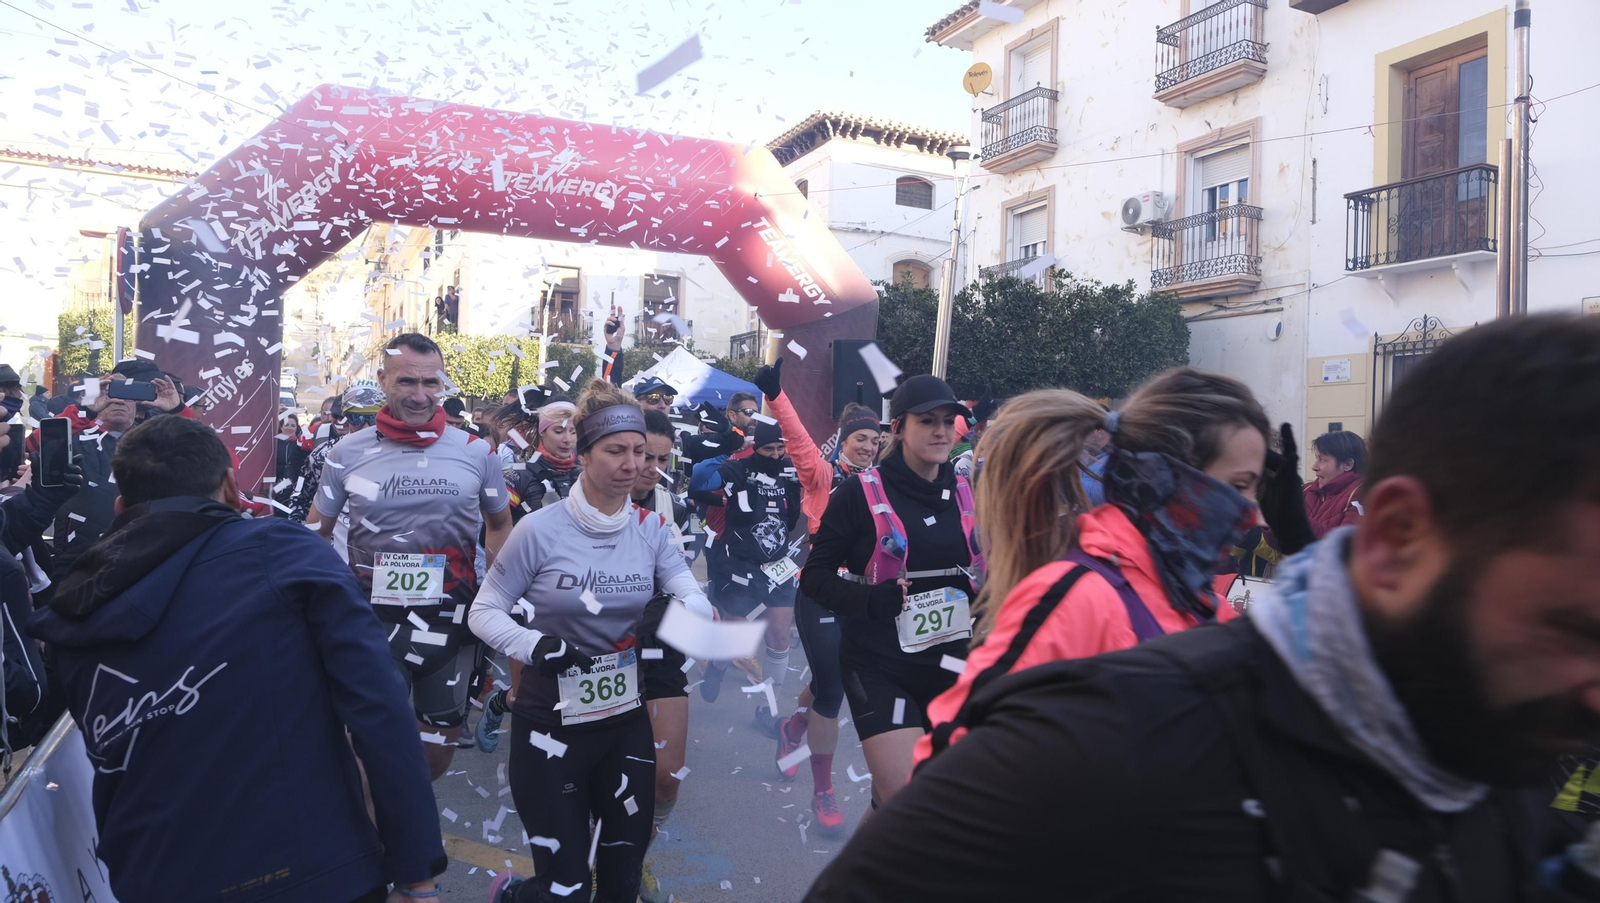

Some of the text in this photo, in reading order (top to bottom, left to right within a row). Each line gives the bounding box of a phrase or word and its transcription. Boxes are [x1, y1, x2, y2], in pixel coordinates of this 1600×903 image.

[503, 170, 627, 201] TEAMERGY
[752, 216, 832, 305] TEAMERGY
[401, 479, 448, 487] CALAR
[771, 560, 788, 577] 237
[386, 571, 430, 591] 202
[598, 574, 642, 584] CALAR
[616, 583, 652, 593] MUNDO
[913, 605, 955, 636] 297
[579, 672, 627, 704] 368
[146, 704, 176, 720] STOP
